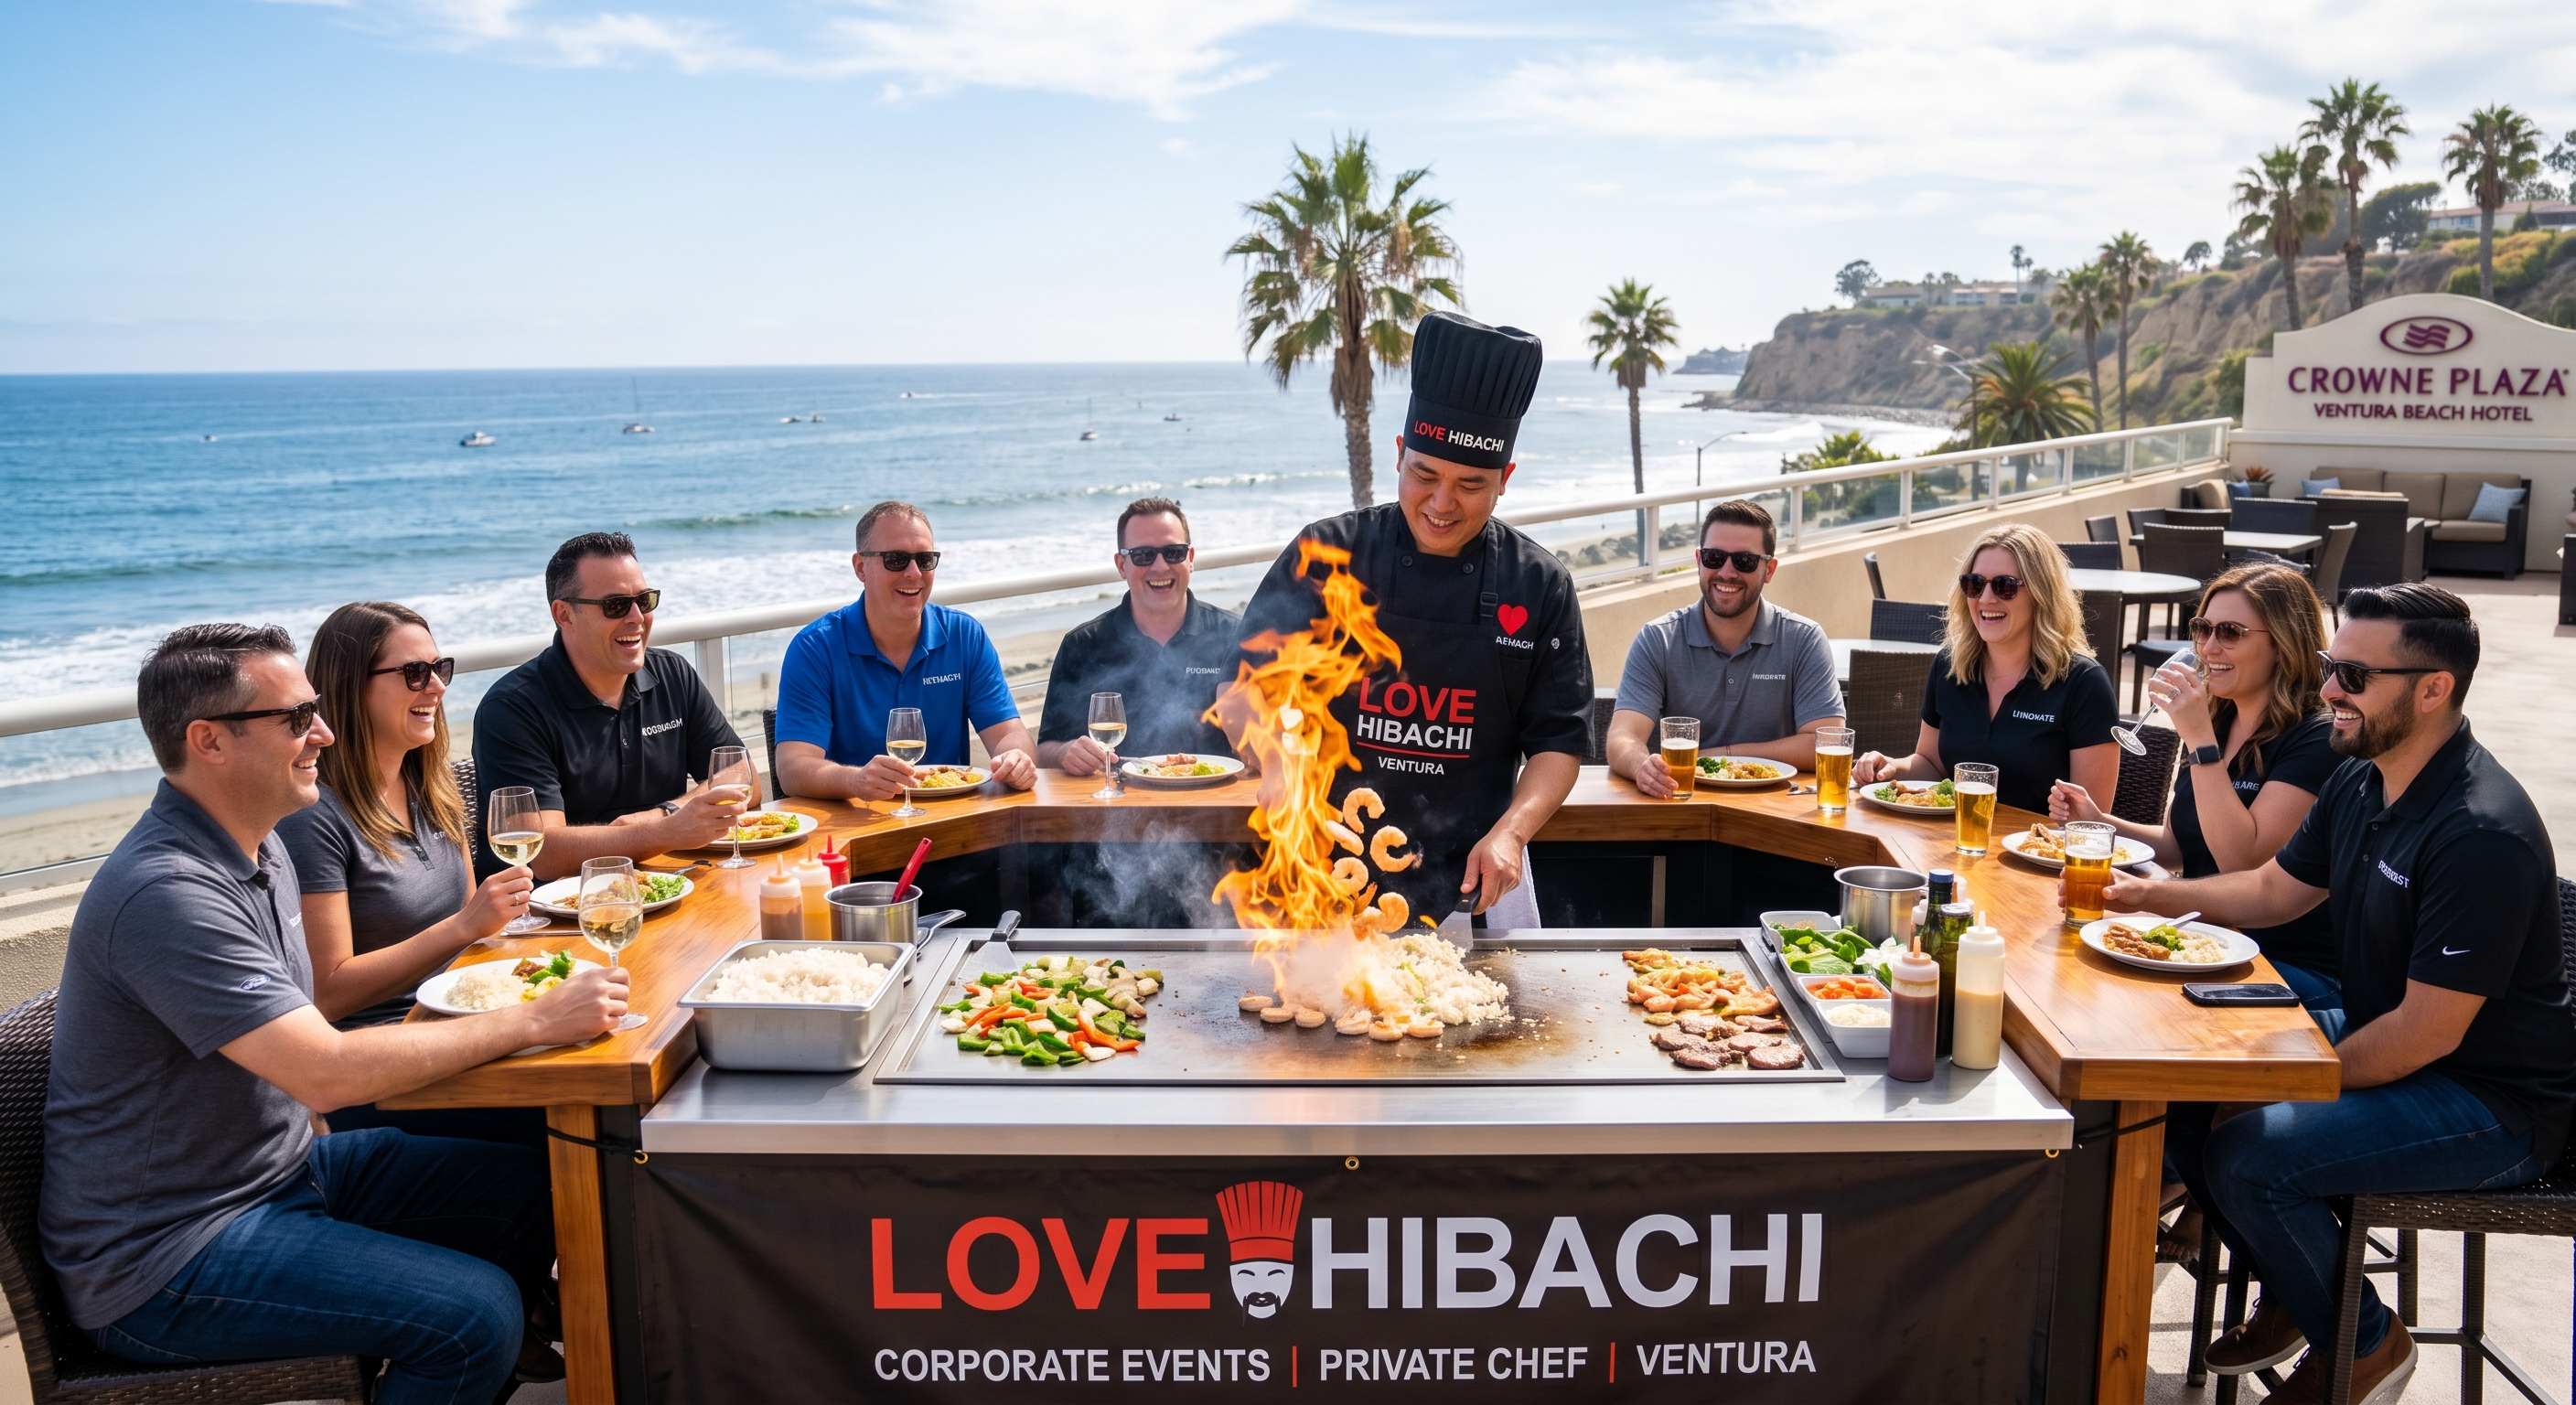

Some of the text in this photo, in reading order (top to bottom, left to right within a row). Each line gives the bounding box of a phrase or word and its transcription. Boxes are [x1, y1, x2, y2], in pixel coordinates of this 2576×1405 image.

[2288, 366, 2567, 397] CROWNE PLAZA
[2313, 402, 2533, 423] VENTURA BEACH HOTEL
[1413, 420, 1505, 453] LOVE HIBACHI
[1358, 676, 1477, 724] LOVE
[1357, 713, 1473, 750] HIBACHI
[1378, 756, 1445, 776] VENTURA
[871, 1213, 1823, 1311] LOVE HIBACHI
[874, 1340, 1818, 1383] CORPORATE EVENTS PRIVATE CHEF VENTURA
